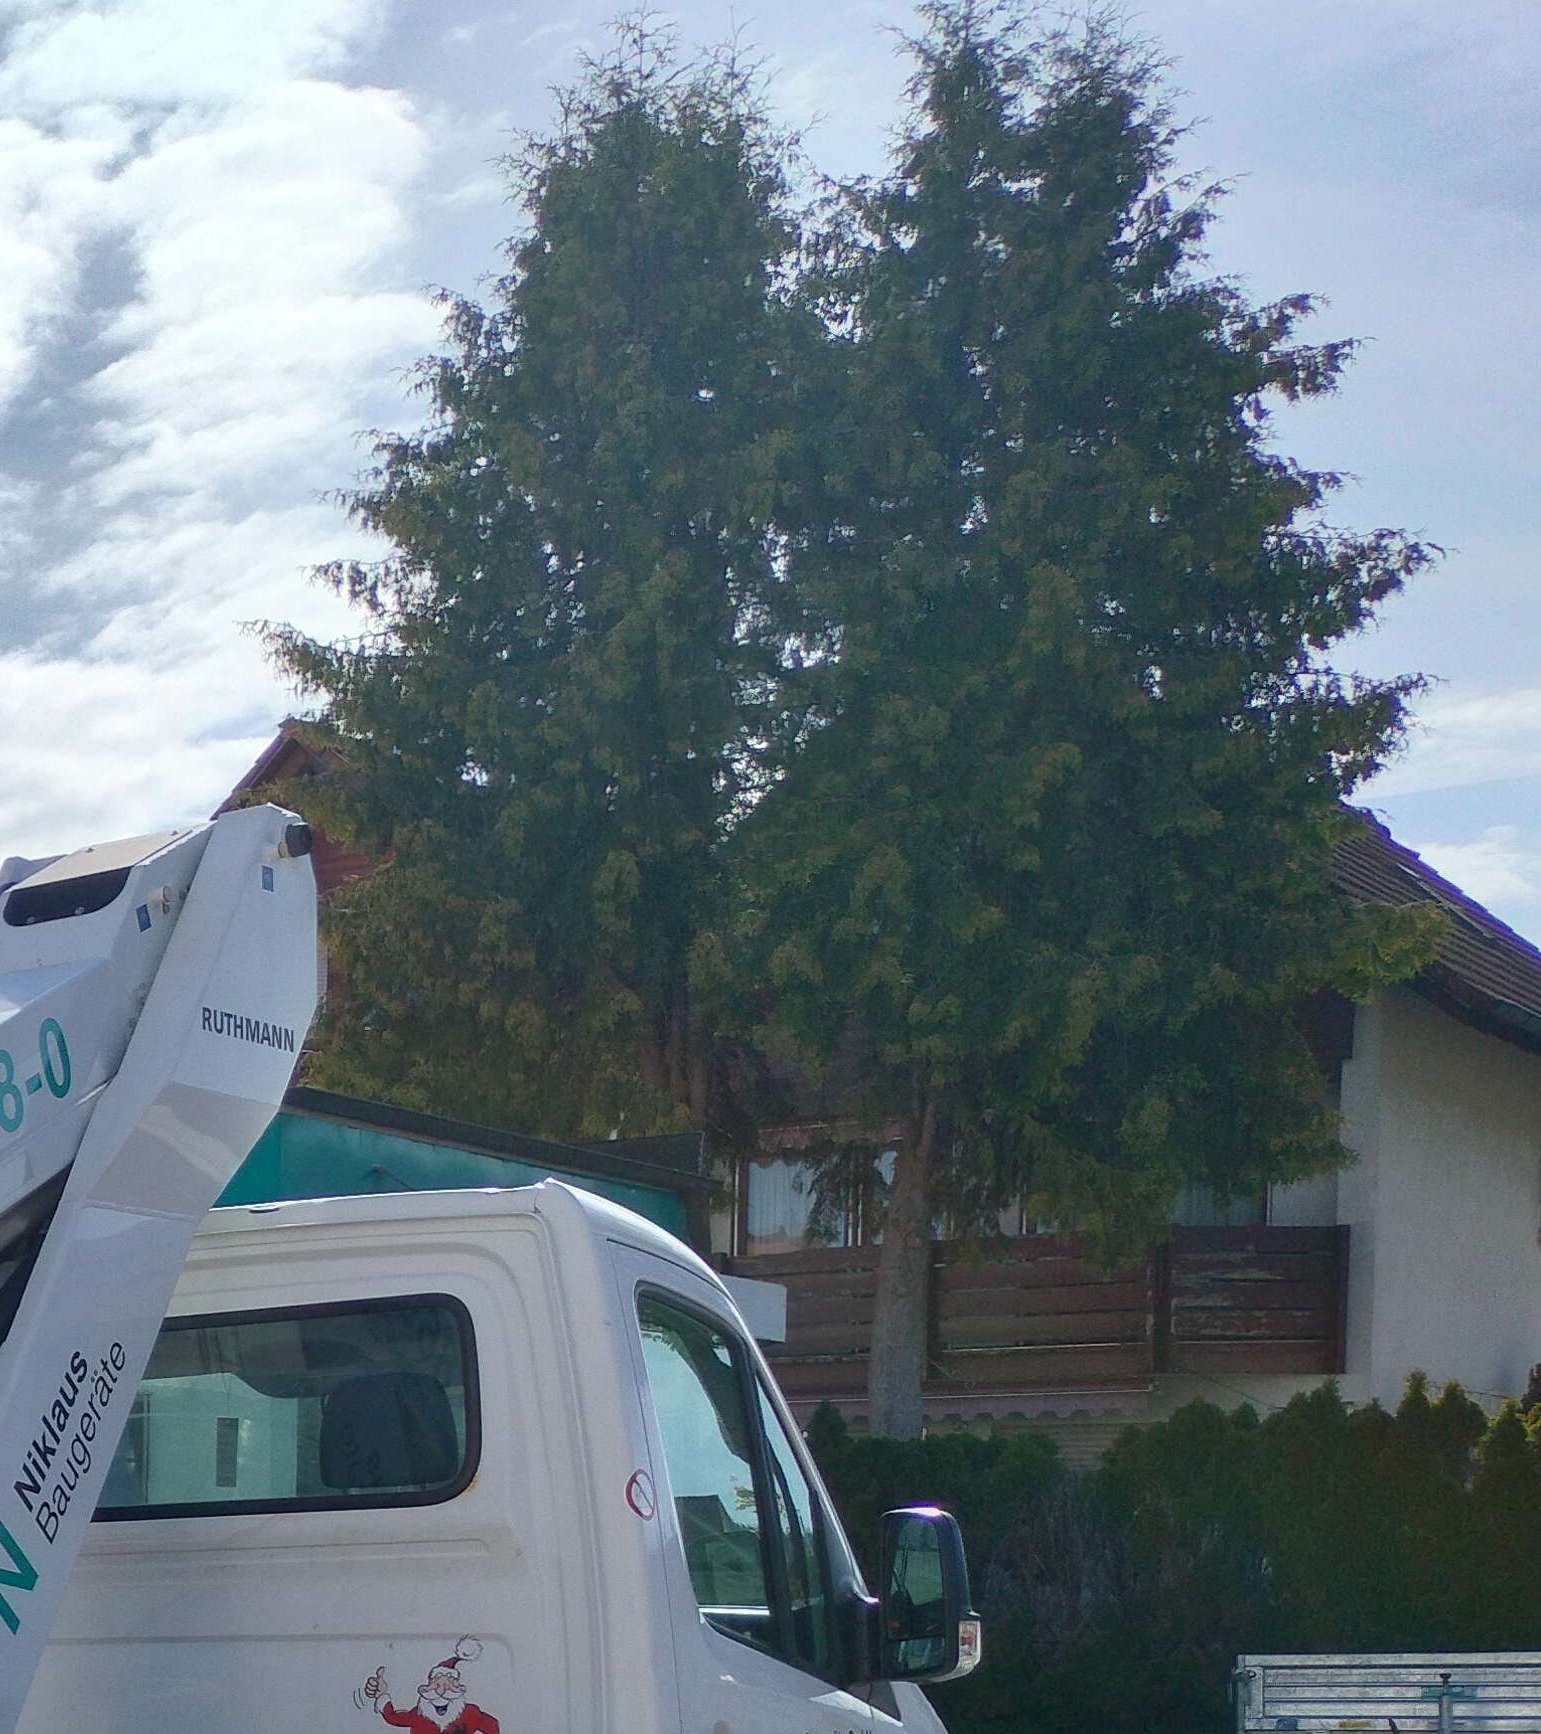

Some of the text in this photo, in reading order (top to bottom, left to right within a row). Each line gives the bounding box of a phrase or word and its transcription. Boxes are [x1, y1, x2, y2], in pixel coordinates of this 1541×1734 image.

[202, 1006, 294, 1053] RUTHMANN
[13, 1351, 88, 1513] Niklaus
[35, 1341, 126, 1545] Baugeräte
